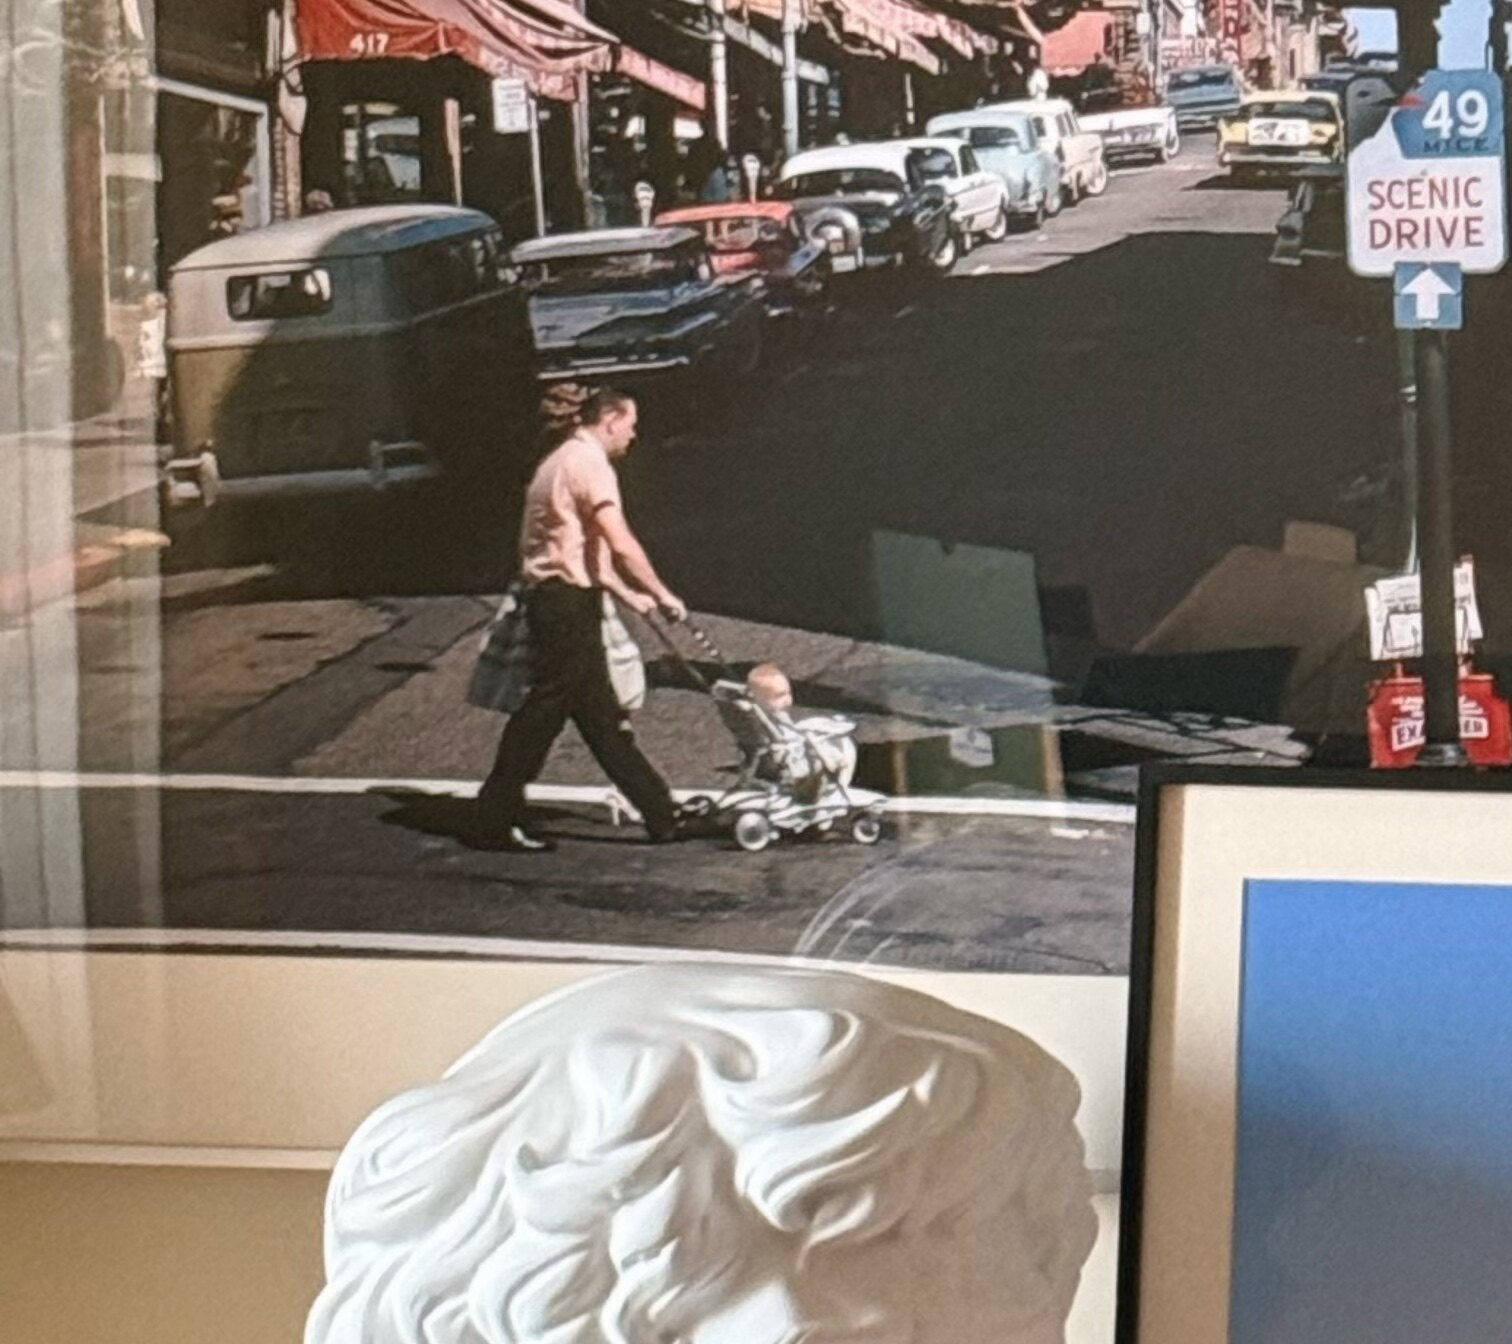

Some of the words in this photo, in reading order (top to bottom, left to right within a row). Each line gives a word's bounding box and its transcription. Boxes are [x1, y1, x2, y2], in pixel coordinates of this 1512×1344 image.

[350, 32, 389, 54] 417
[1422, 89, 1489, 139] 49
[1367, 177, 1483, 211] SCENIC
[1368, 216, 1485, 250] DRIVE
